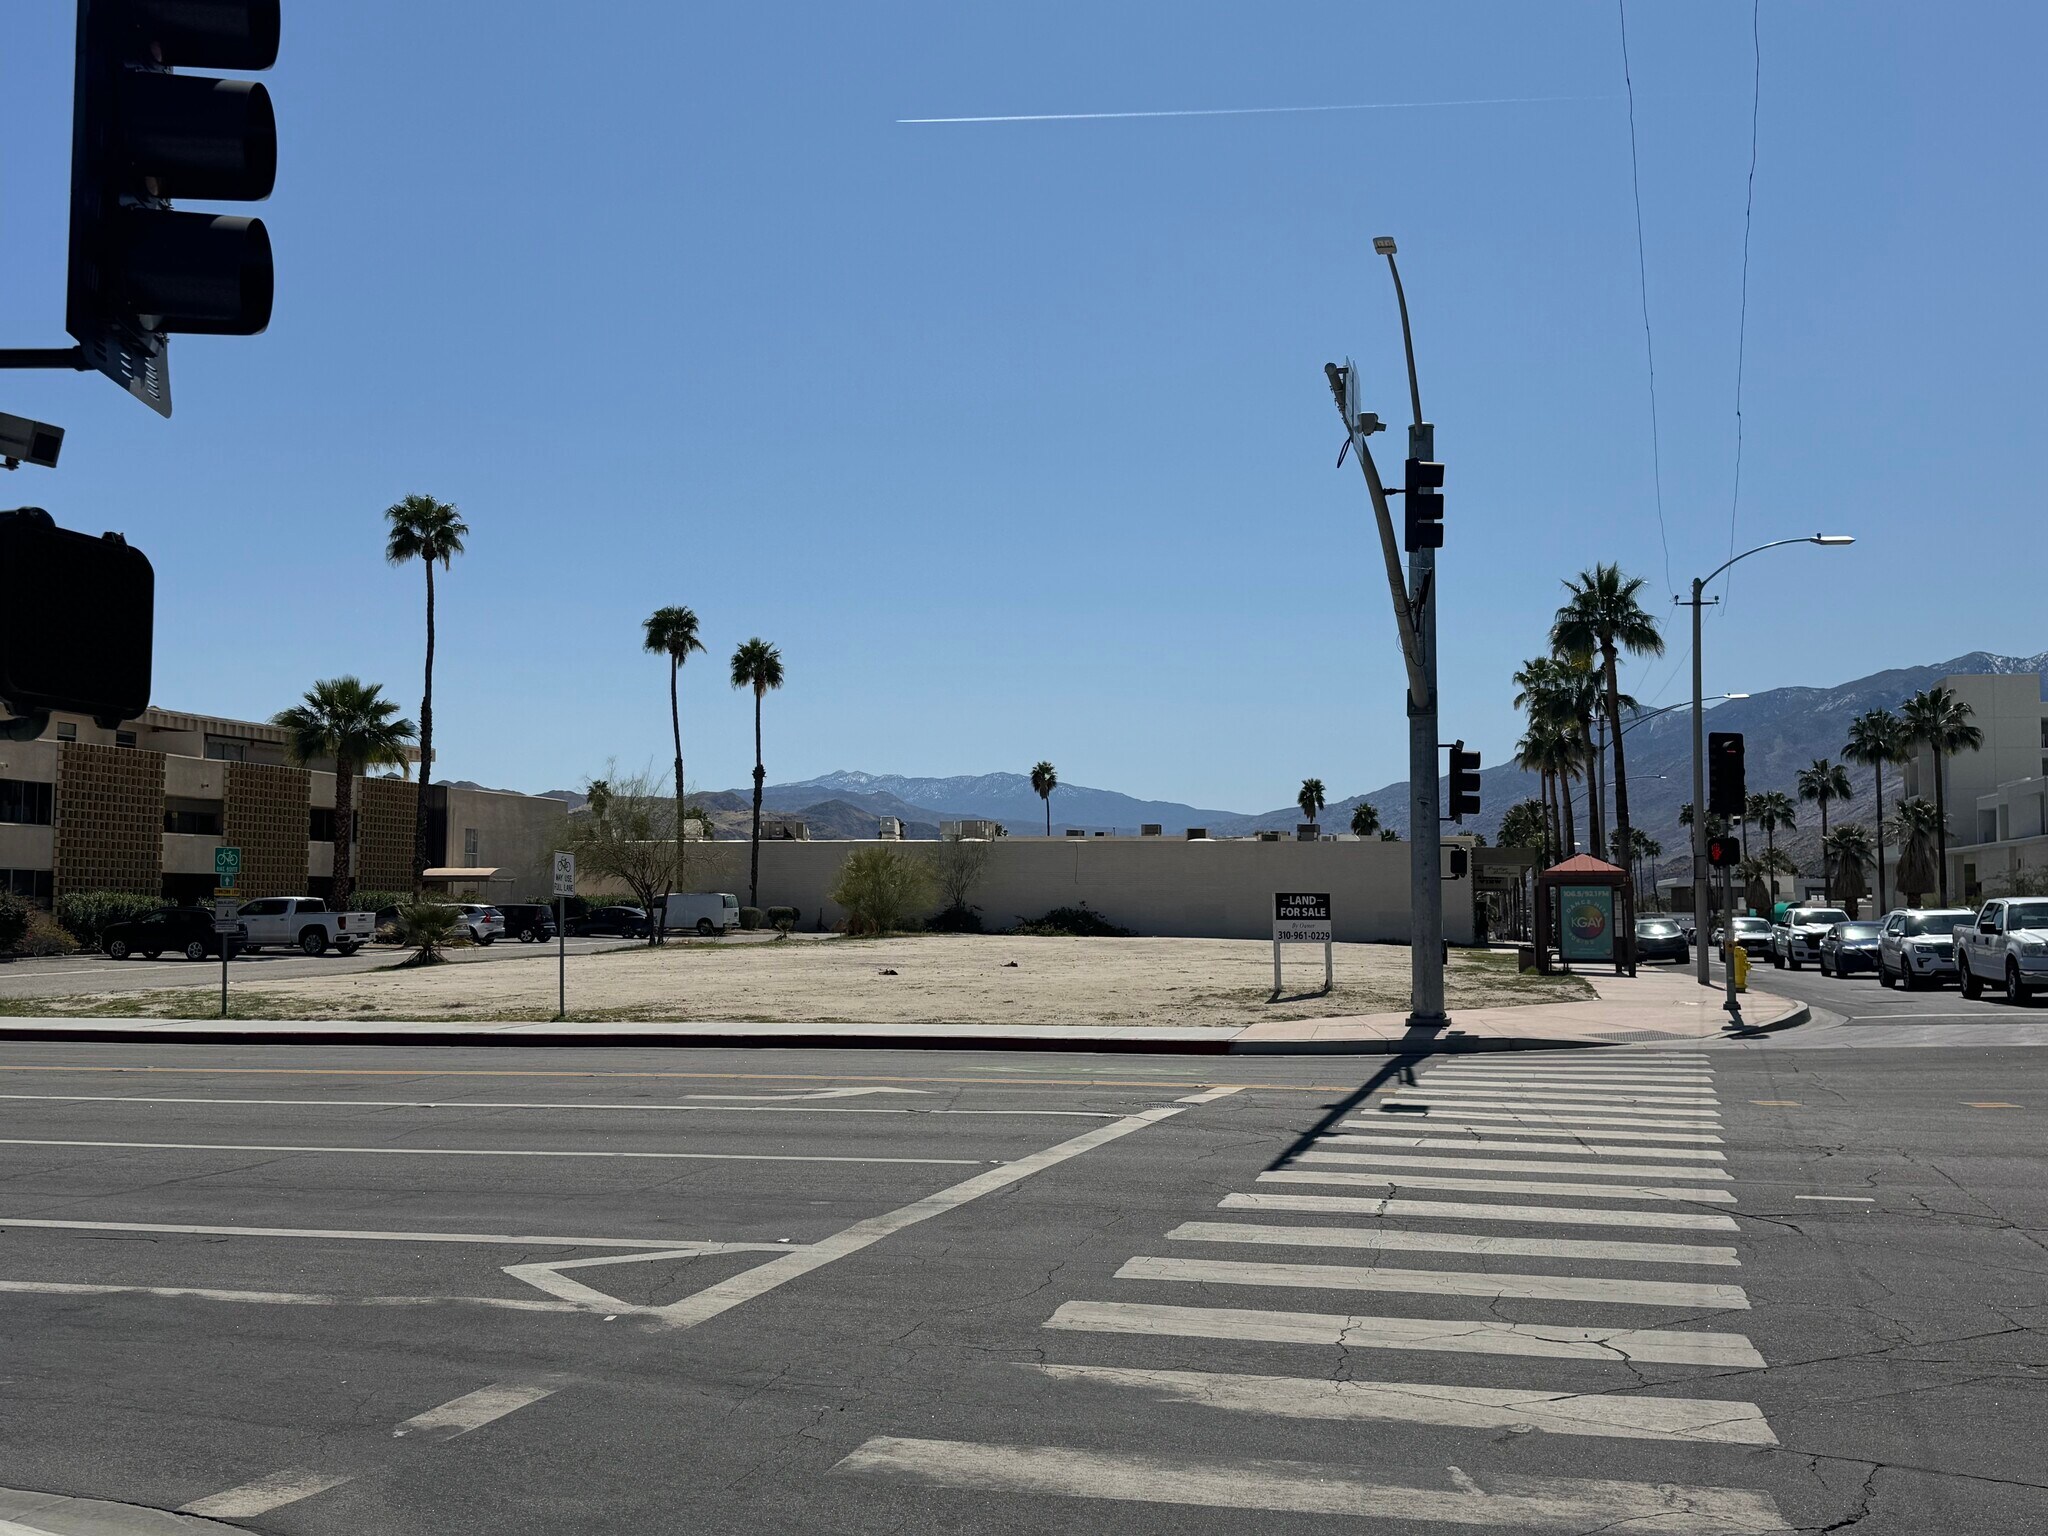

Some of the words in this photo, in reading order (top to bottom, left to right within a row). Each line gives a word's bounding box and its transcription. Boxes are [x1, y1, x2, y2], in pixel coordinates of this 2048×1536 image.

[563, 884, 574, 892] LANE
[1566, 899, 1591, 914] DANCE
[1280, 907, 1300, 917] FOR
[1302, 907, 1326, 917] SALE
[1571, 916, 1603, 928] KGAY
[1278, 931, 1330, 940] 310-961-0229
